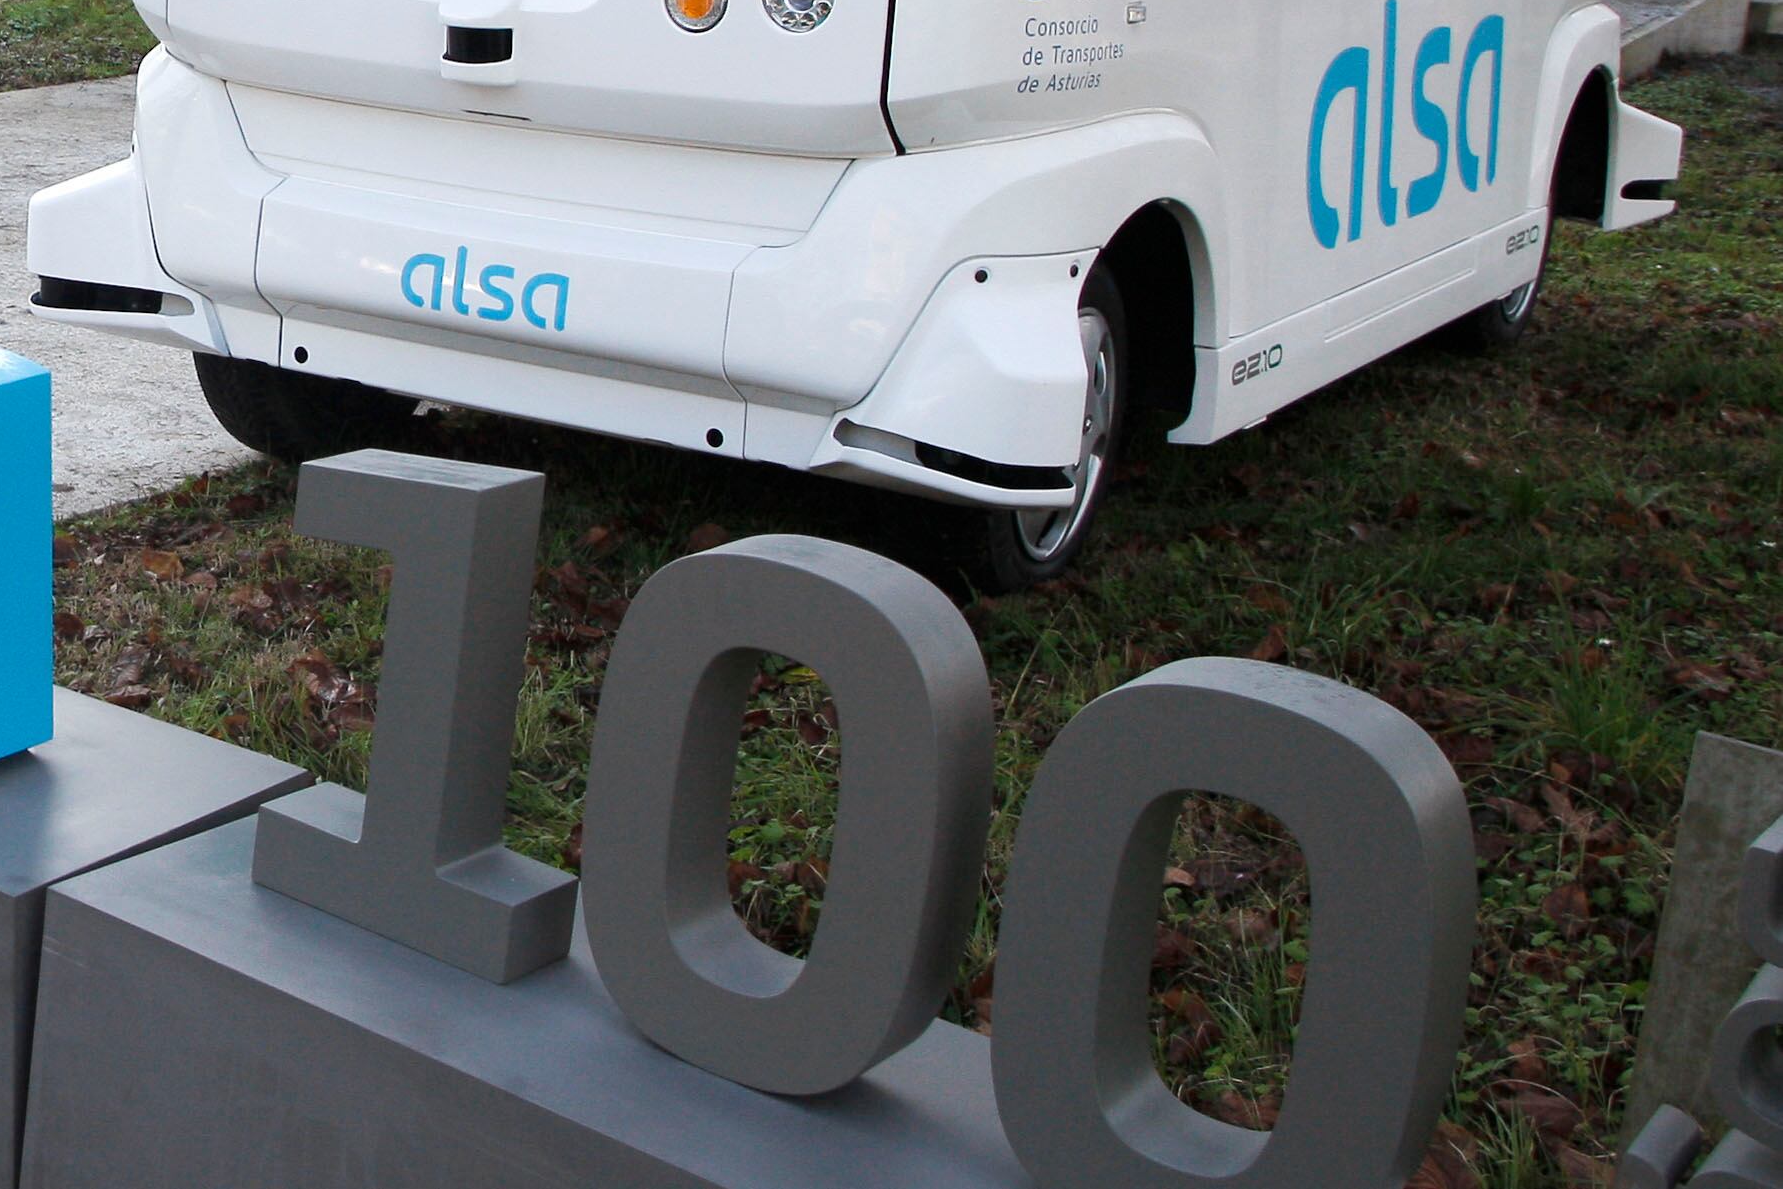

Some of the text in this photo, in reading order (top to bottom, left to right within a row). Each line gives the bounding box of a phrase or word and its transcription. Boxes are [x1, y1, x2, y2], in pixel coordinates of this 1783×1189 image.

[1025, 15, 1099, 37] Consorcio
[1022, 41, 1124, 67] de Transportes
[1017, 72, 1102, 94] de Asturias
[401, 245, 570, 332] alsa
[251, 449, 1478, 1189] 100
